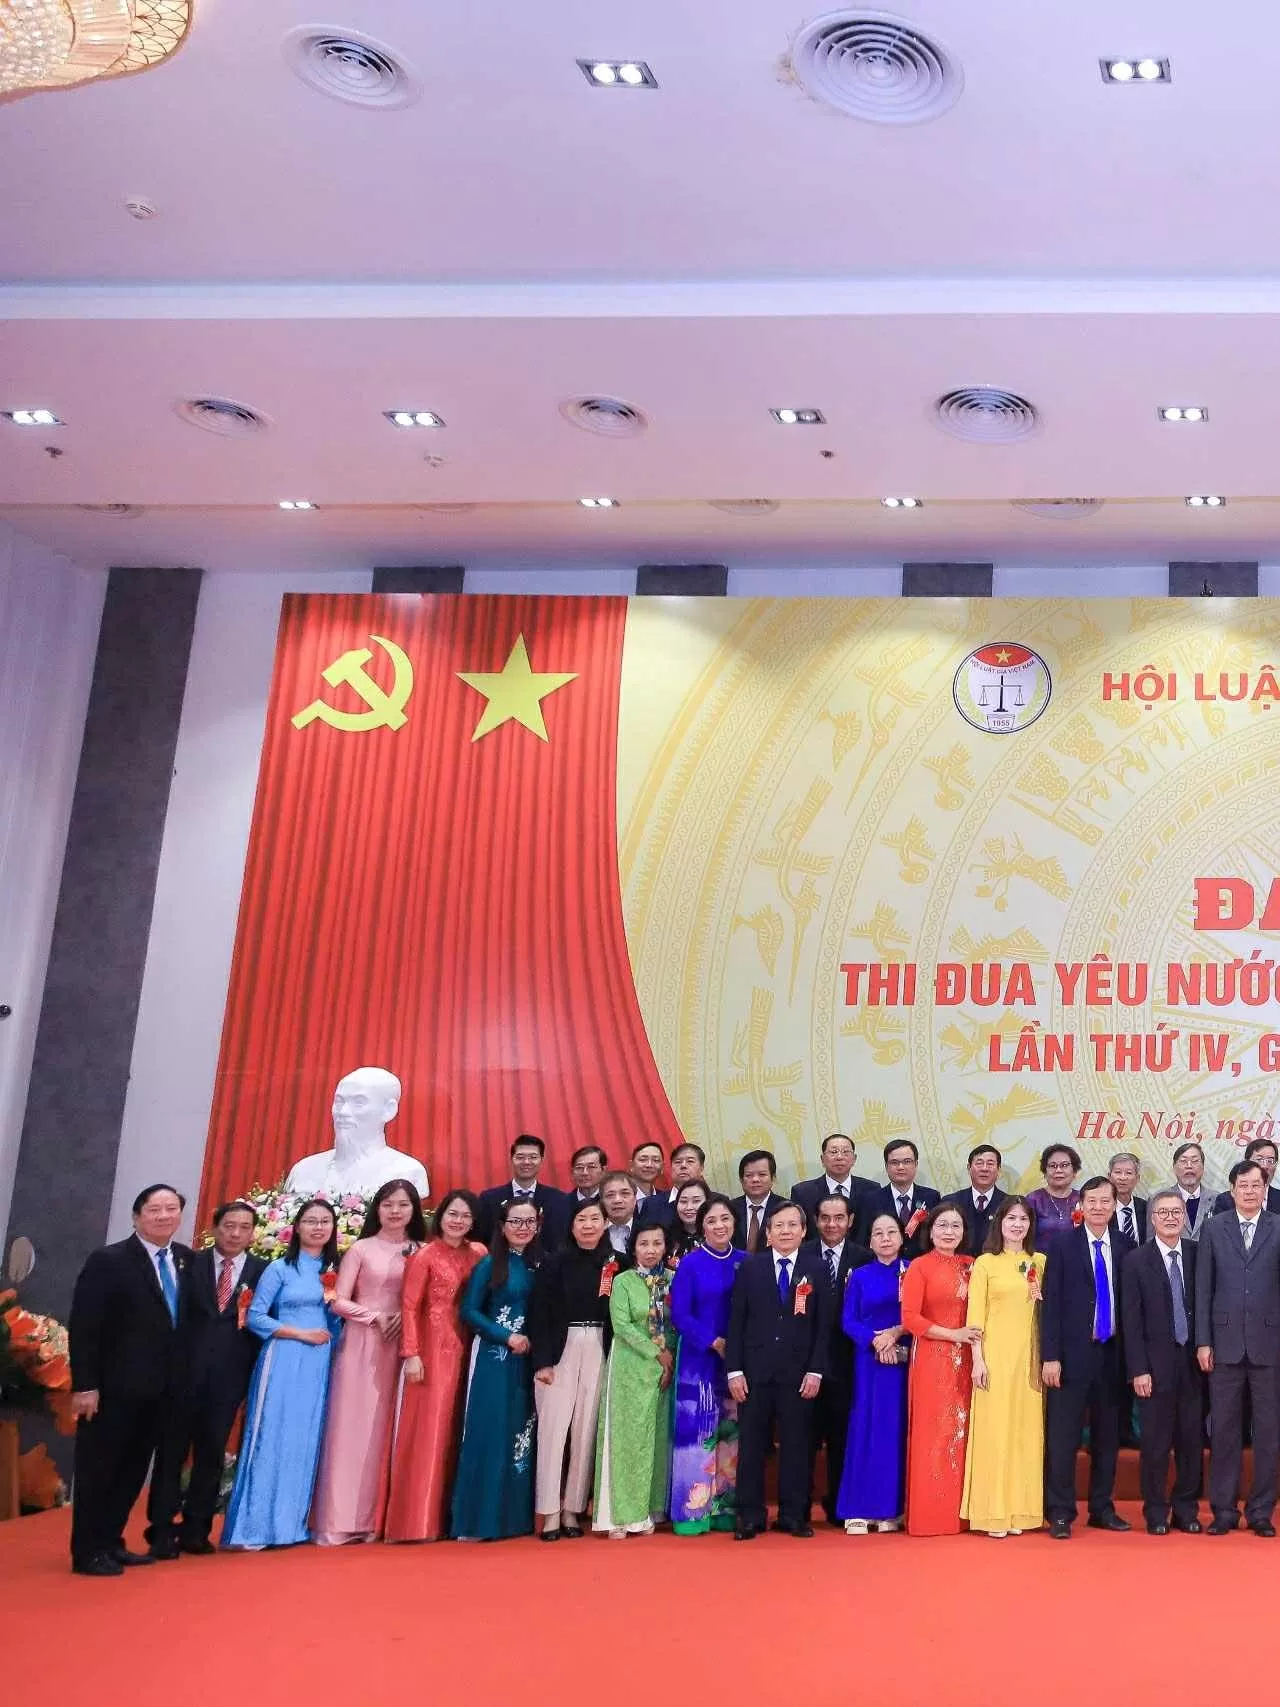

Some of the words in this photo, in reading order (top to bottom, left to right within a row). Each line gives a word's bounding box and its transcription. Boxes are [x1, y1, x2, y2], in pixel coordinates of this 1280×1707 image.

[1103, 665, 1177, 710] HỘI
[840, 962, 917, 1006] THI
[935, 962, 1036, 1006] ĐUA
[1055, 953, 1149, 1006] YÊU
[989, 1021, 1074, 1072] LẦN
[1090, 1023, 1179, 1073] THỨ
[1190, 1034, 1241, 1077] IV,
[1075, 1111, 1127, 1139] Hà
[1136, 1111, 1203, 1146] Nội,
